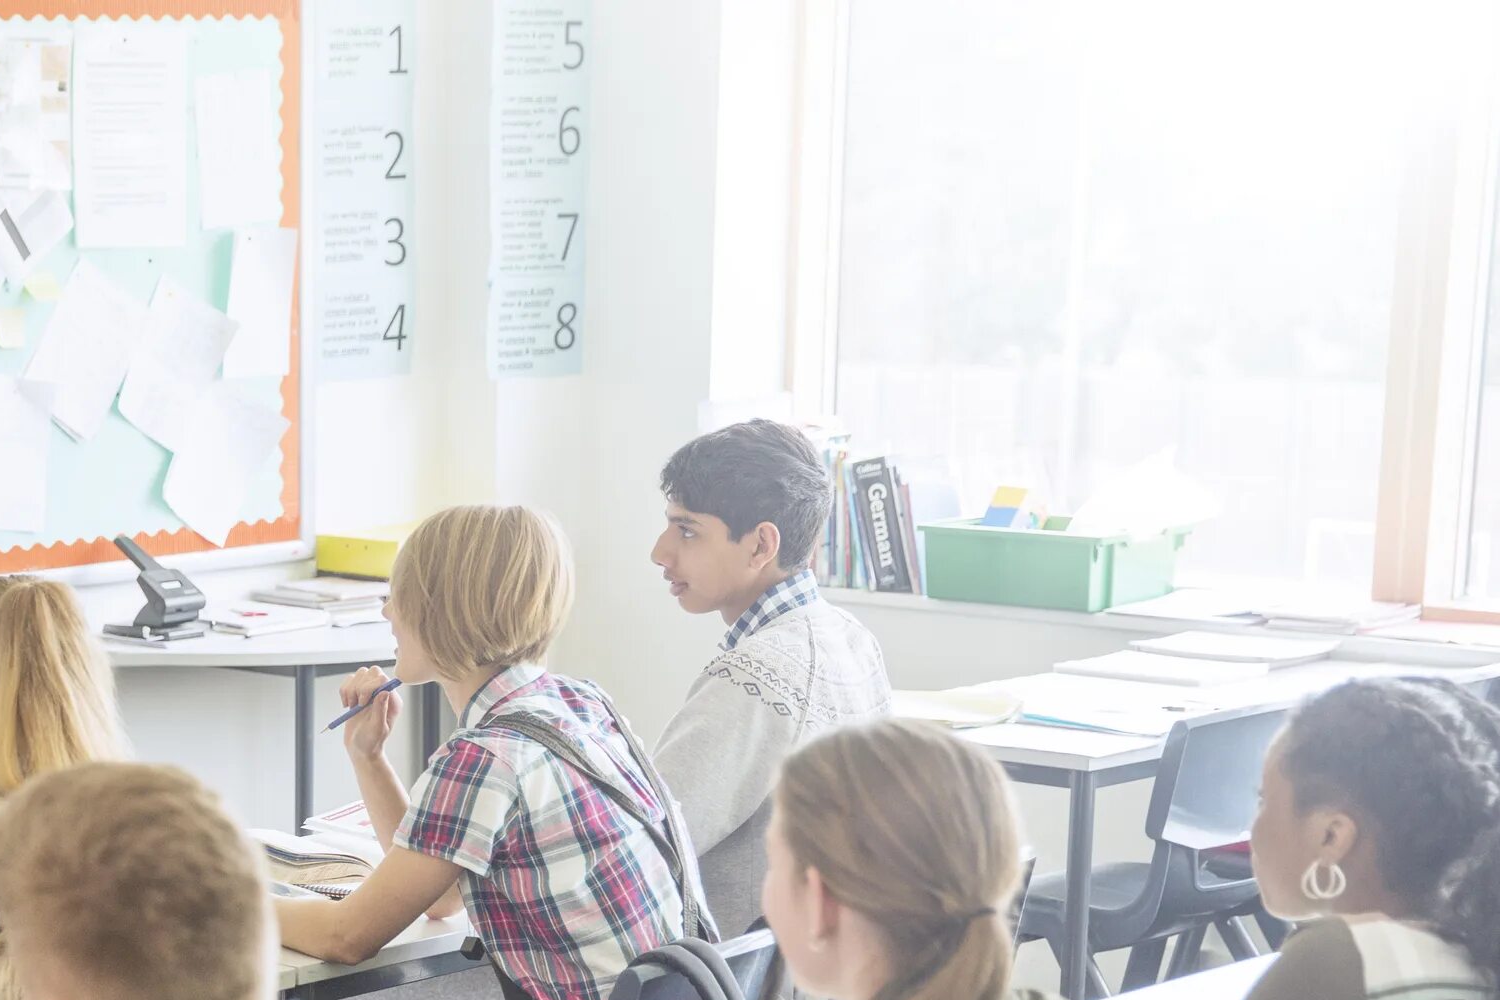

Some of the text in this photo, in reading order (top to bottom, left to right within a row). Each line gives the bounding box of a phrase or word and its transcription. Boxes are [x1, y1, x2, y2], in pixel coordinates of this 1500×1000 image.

[388, 24, 408, 75] 1
[562, 20, 585, 70] 5
[384, 130, 407, 180] 2
[559, 106, 581, 156] 6
[384, 217, 407, 267] 3
[556, 213, 579, 262] 7
[382, 304, 408, 352] 4
[554, 302, 578, 351] 8
[867, 482, 893, 569] German
